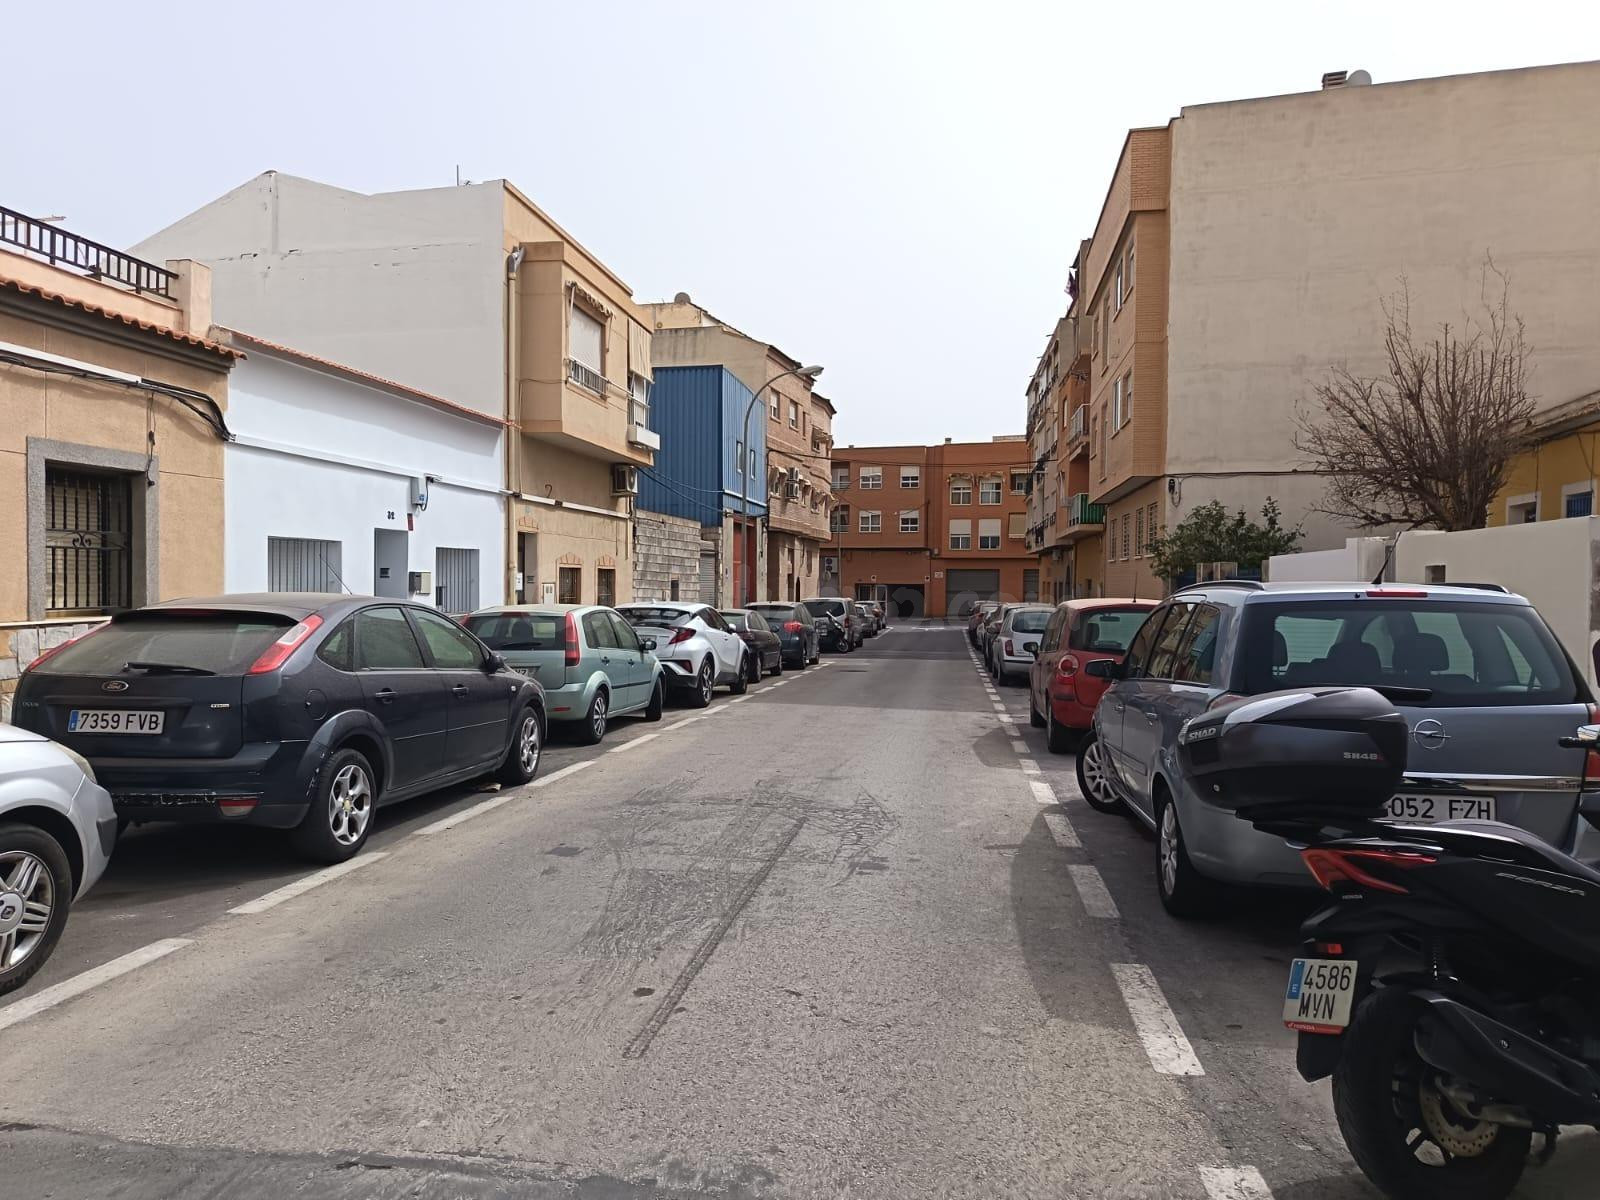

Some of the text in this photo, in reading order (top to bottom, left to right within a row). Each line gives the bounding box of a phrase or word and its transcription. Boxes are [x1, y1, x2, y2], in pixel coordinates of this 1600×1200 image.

[79, 713, 160, 731] 7359 FVB
[1188, 727, 1217, 741] SHAD
[1387, 796, 1491, 821] 052 FZH
[1303, 964, 1352, 992] 4586
[1298, 991, 1336, 1020] MVN
